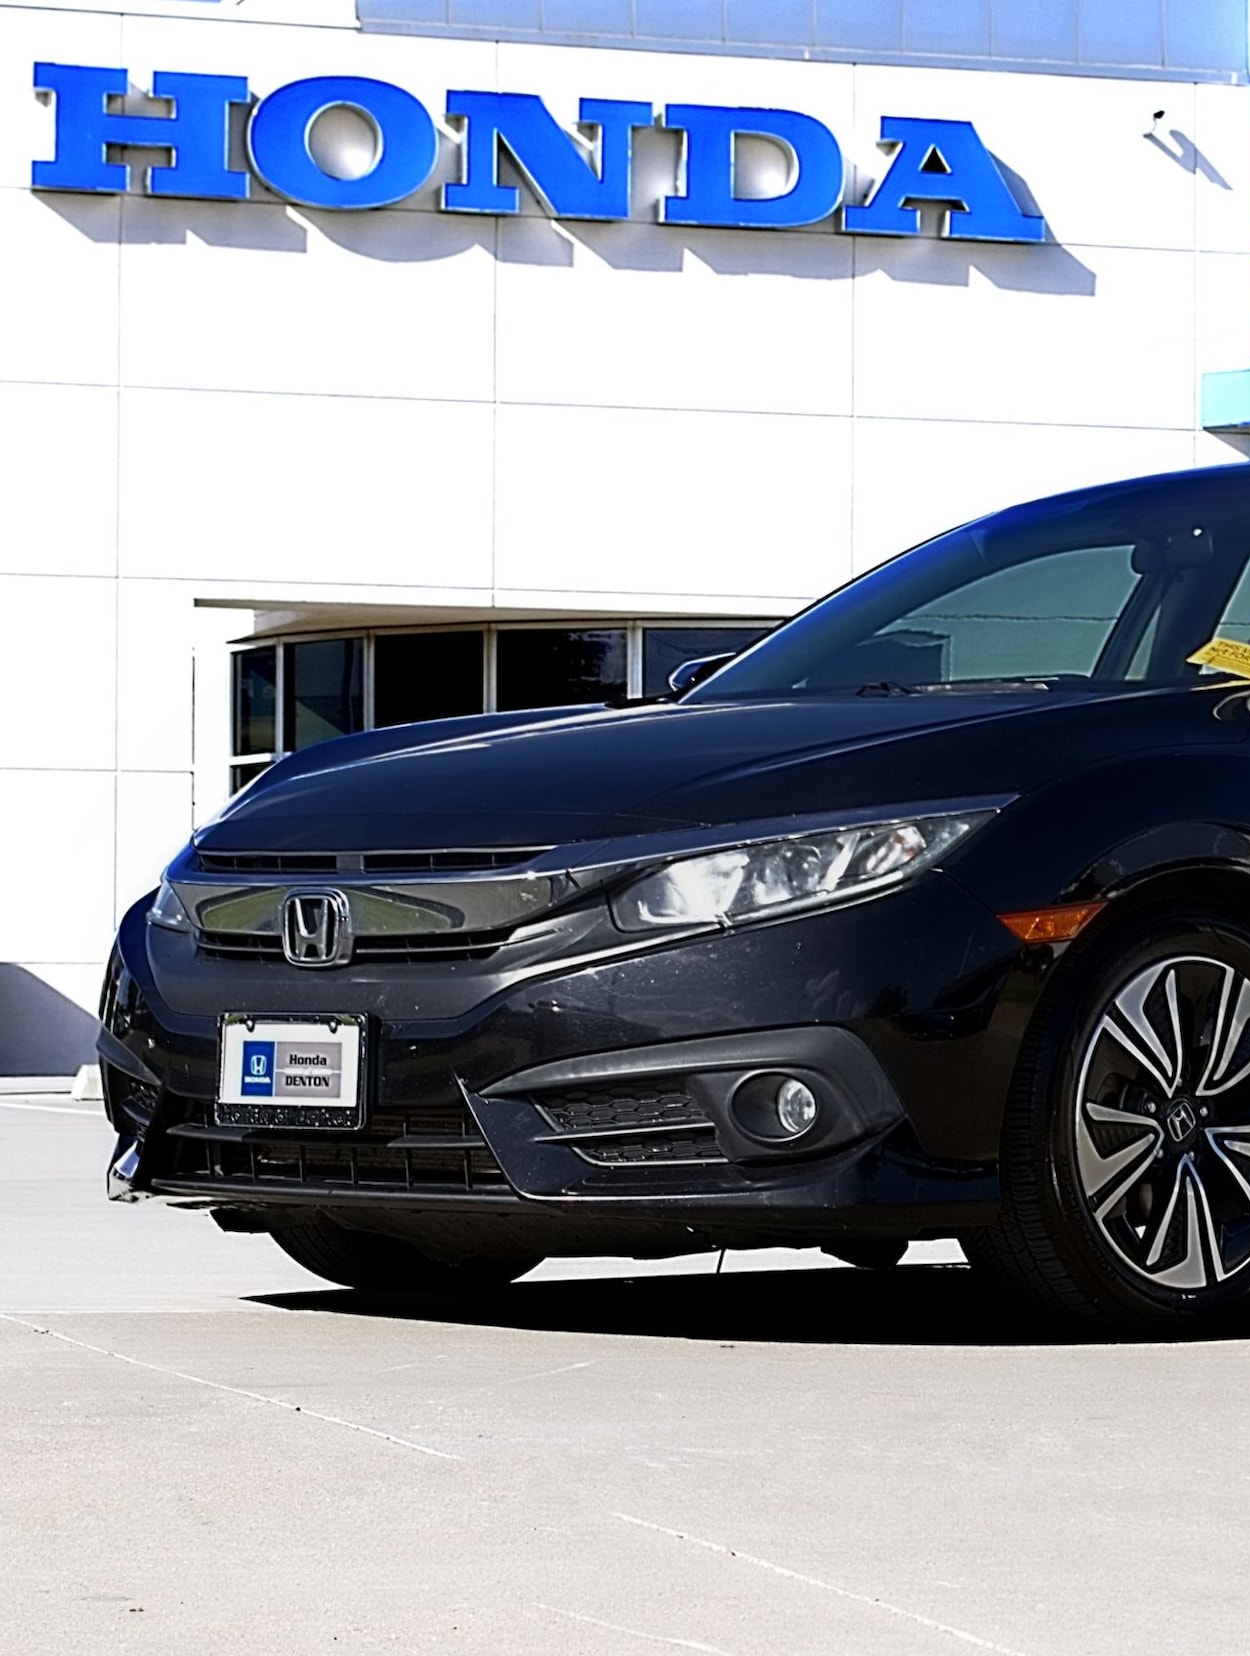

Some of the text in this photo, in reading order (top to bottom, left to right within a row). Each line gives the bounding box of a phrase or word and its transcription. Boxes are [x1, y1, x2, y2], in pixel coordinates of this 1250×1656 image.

[32, 62, 1046, 242] HONDA
[289, 1054, 327, 1066] Honda
[285, 1076, 330, 1087] DENTON
